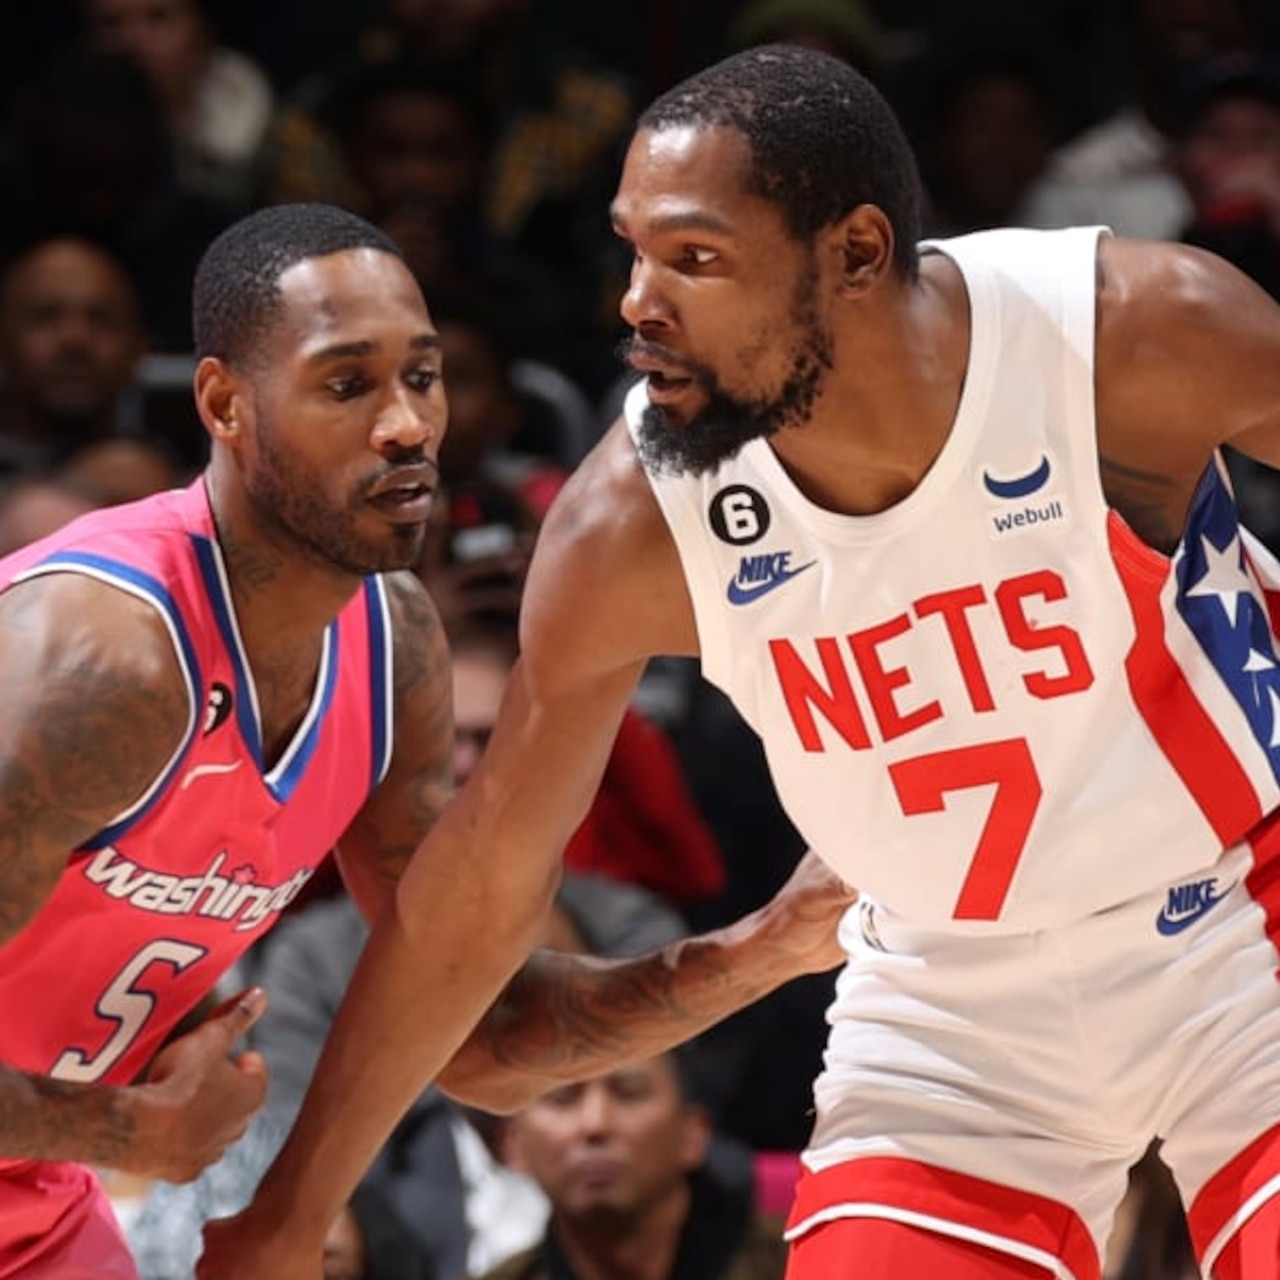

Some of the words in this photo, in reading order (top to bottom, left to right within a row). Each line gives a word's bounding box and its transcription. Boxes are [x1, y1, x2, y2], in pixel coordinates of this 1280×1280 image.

[721, 491, 760, 540] 6
[993, 502, 1063, 533] Webull
[738, 550, 793, 584] NIKE
[768, 568, 1095, 753] NETS
[887, 736, 1043, 922] 7
[1166, 877, 1219, 916] NIKE
[49, 937, 209, 1084] 5
